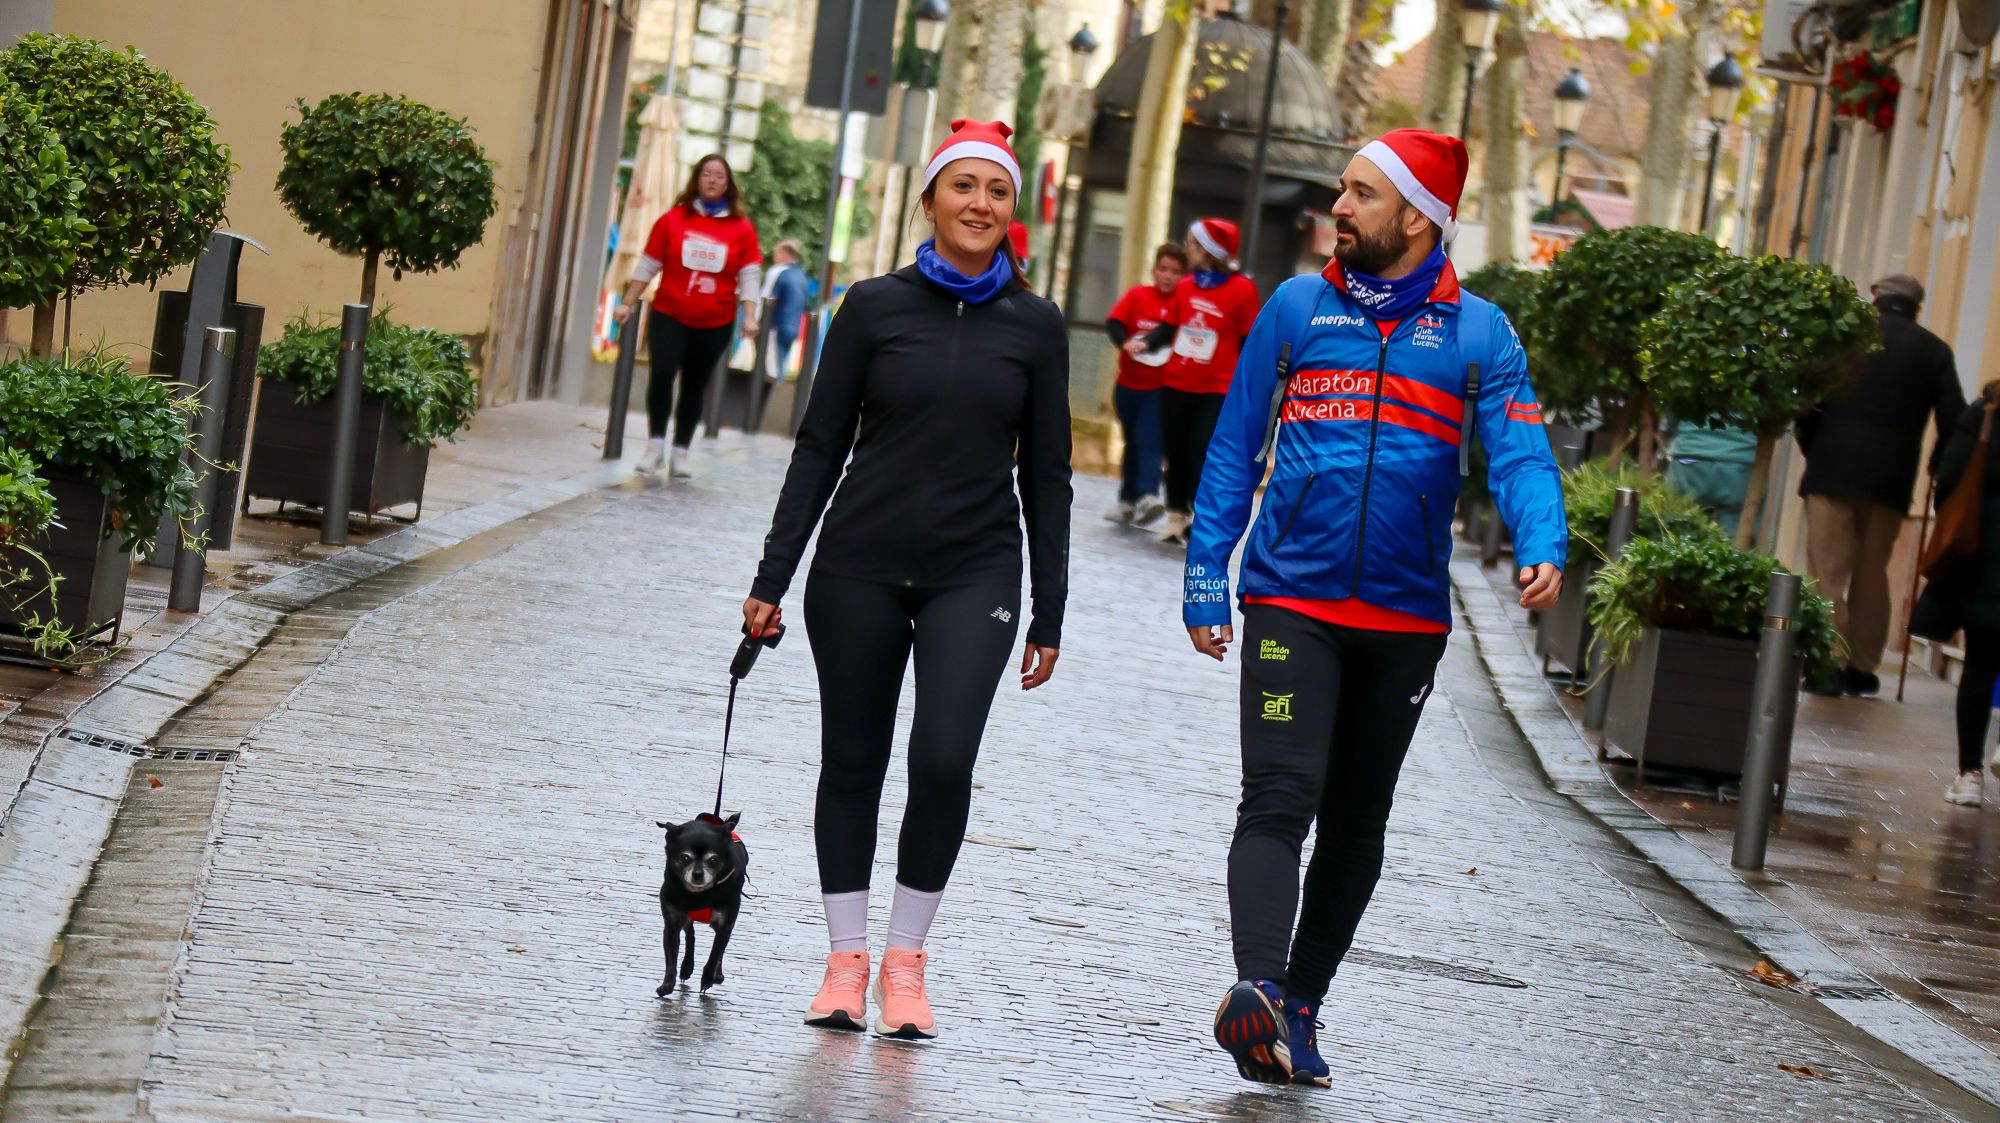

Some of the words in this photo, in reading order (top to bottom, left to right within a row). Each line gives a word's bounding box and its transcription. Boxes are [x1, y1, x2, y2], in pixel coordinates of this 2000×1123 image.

[1311, 315, 1365, 327] enerplus
[1415, 326, 1433, 335] Club
[1412, 340, 1439, 349] Lucena
[1289, 371, 1371, 395] Maratón
[1288, 402, 1355, 420] Lucena
[1260, 653, 1287, 661] Lucena
[1264, 697, 1290, 714] efi
